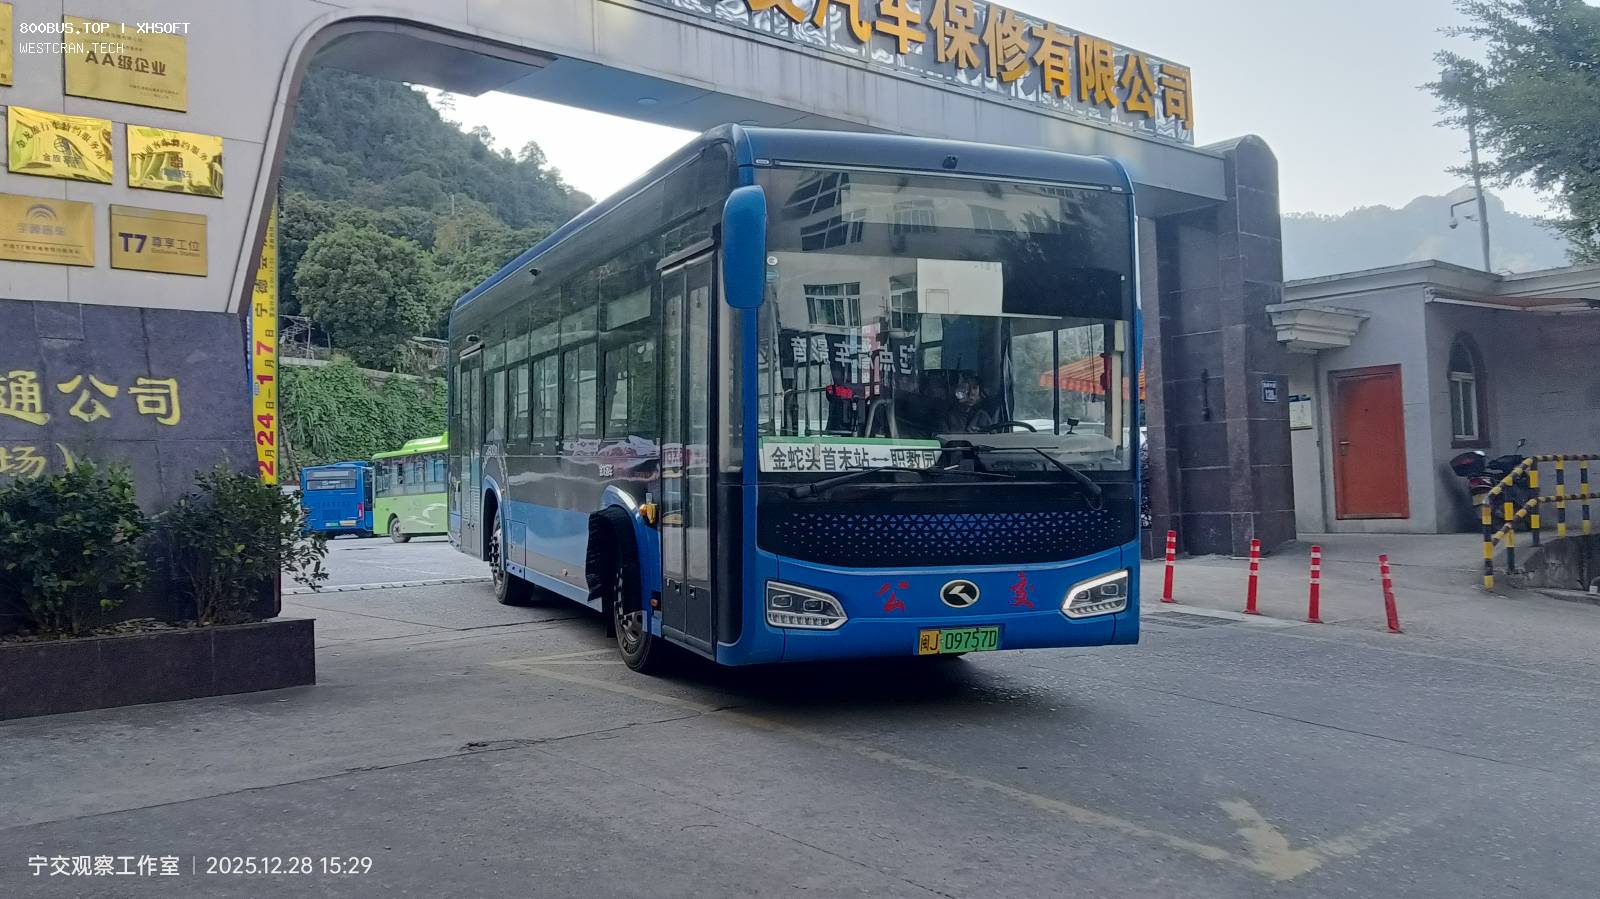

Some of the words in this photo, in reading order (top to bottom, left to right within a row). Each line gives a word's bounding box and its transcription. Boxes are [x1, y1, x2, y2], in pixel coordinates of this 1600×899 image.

[85, 50, 166, 77] AA级企业
[118, 232, 147, 253] T7
[876, 580, 909, 613] 公
[1009, 571, 1035, 610] 交
[945, 630, 998, 650] 09757D
